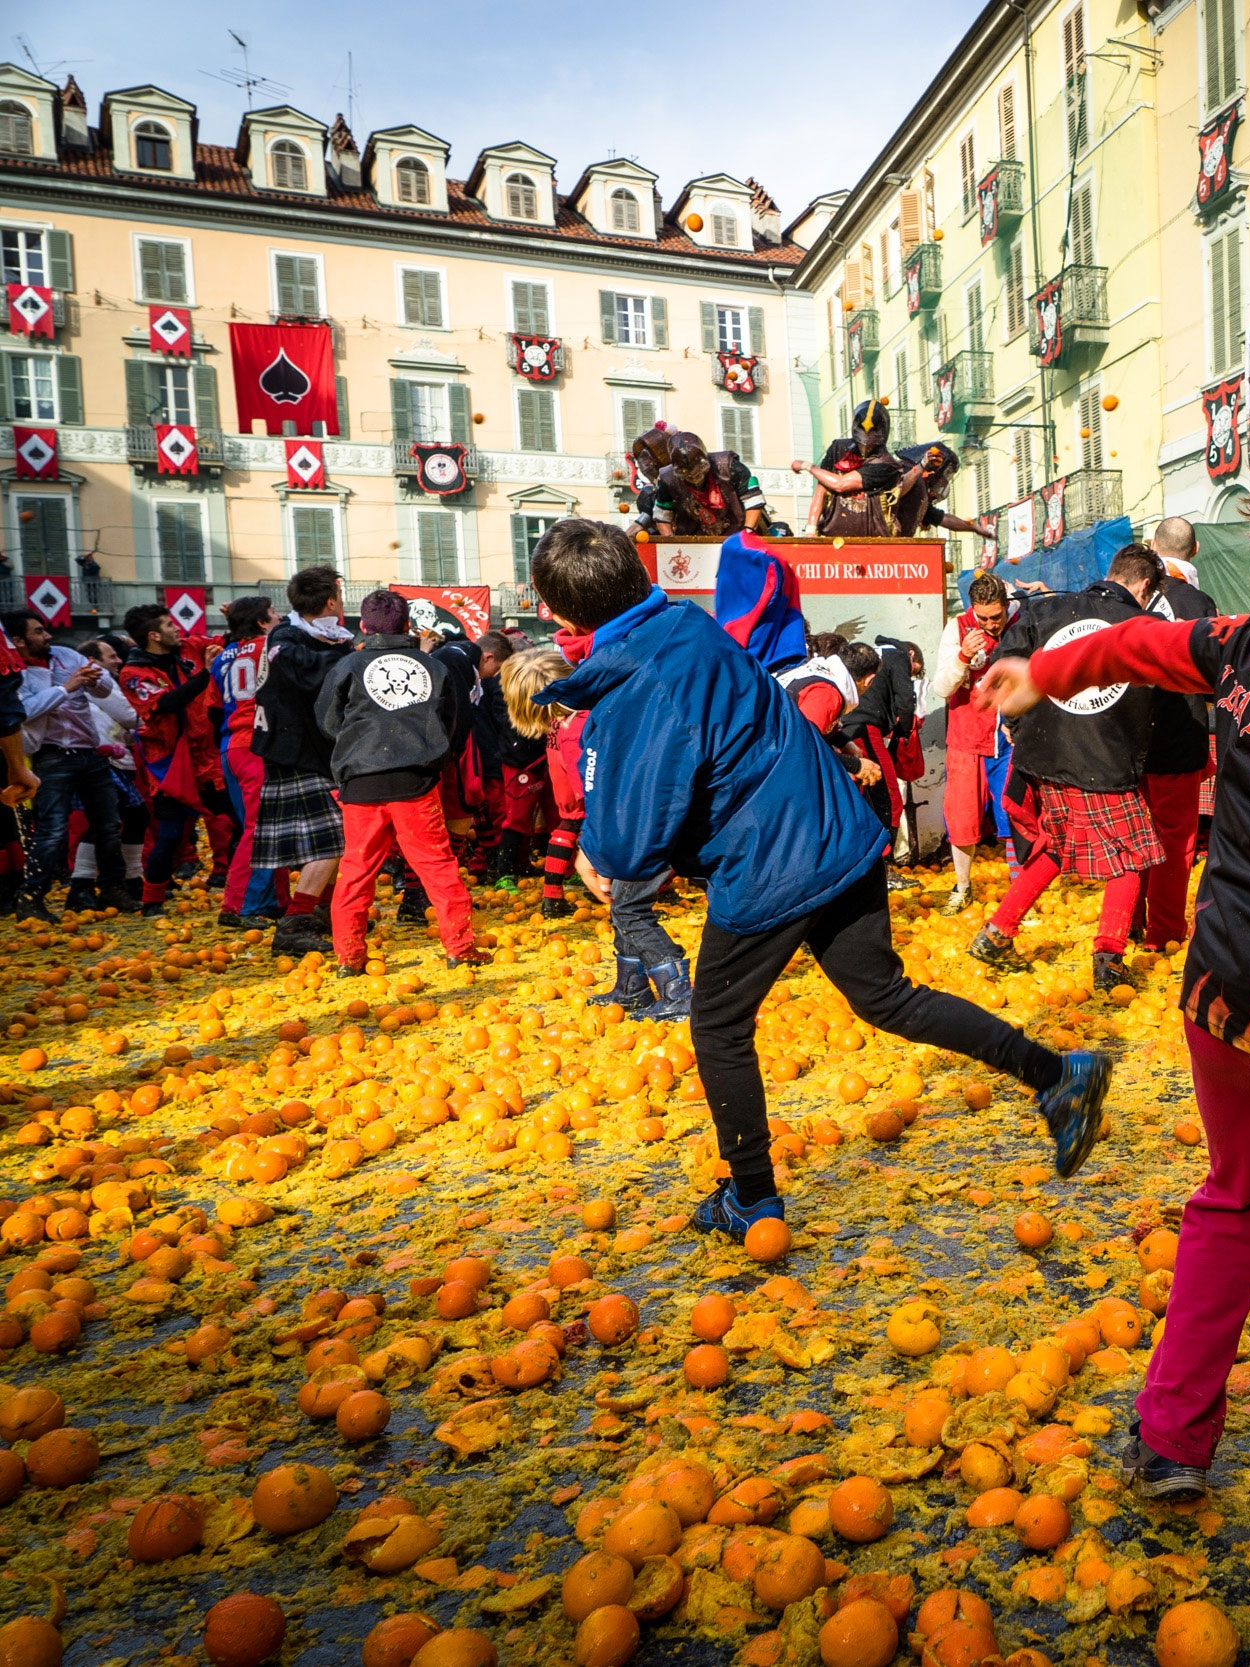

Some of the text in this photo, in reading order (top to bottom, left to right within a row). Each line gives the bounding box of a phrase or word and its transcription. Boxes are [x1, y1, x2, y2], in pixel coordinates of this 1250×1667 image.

[522, 362, 550, 375] 5 4
[1211, 402, 1216, 421] 1
[1209, 438, 1233, 463] 5 4
[824, 563, 840, 579] DI
[864, 563, 929, 579] ARDUINO
[441, 590, 489, 621] FONDO
[541, 608, 549, 618] 5
